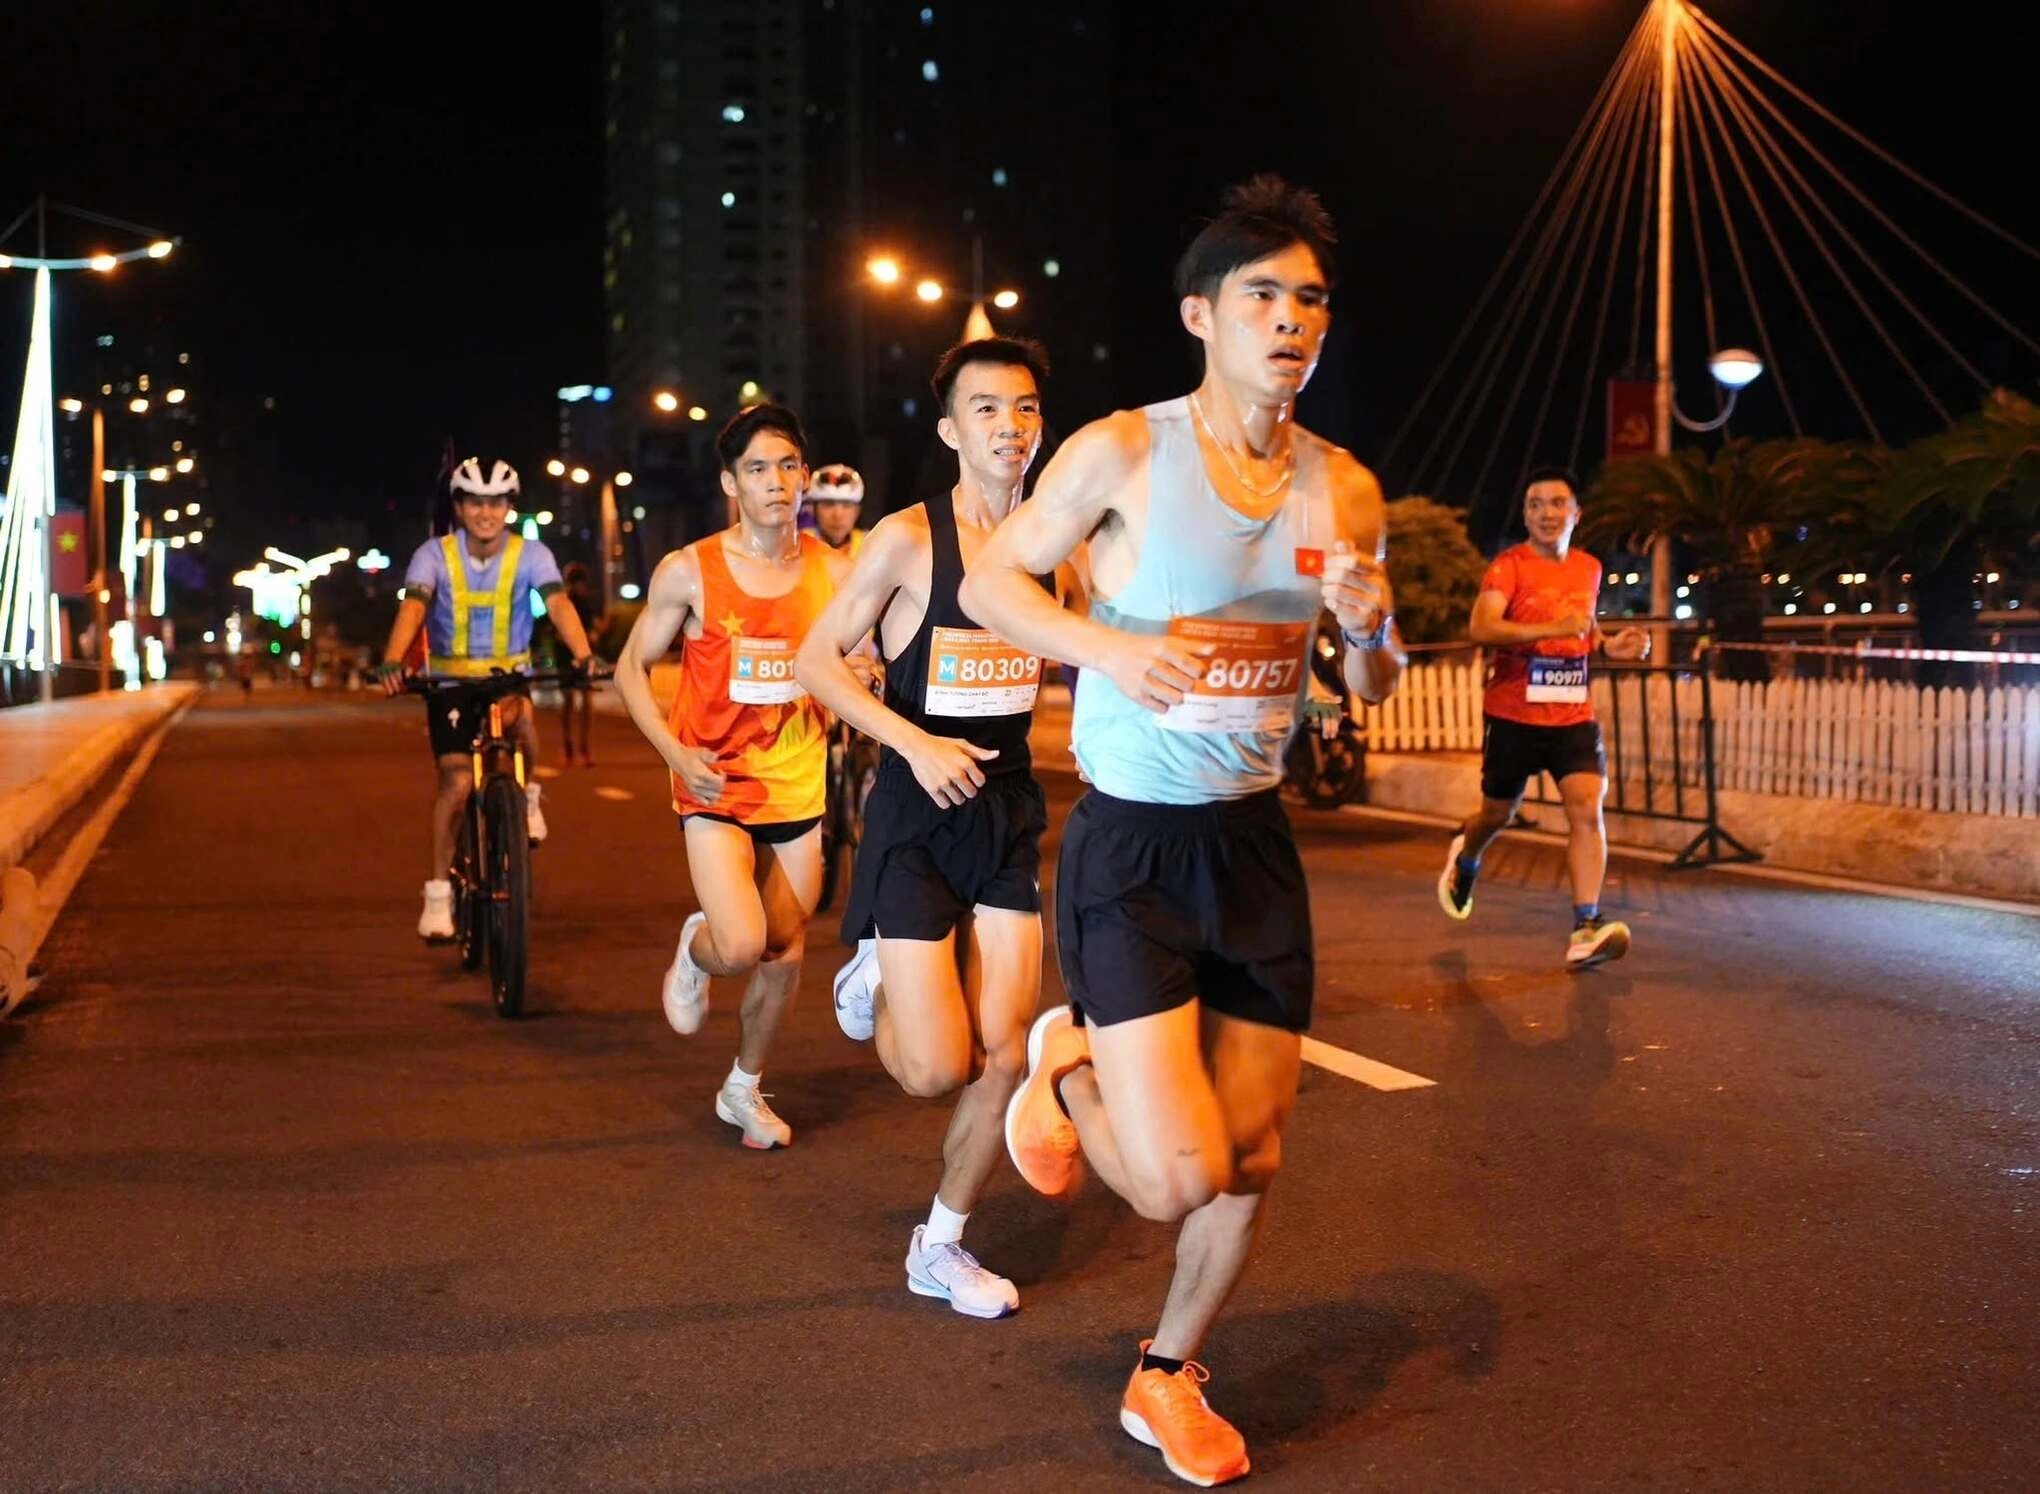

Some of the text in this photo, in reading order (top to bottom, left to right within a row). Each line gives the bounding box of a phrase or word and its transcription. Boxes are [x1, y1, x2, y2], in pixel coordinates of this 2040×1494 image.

[738, 660, 752, 674] M
[940, 656, 1038, 681] M 80309
[1206, 658, 1298, 689] 80757
[1545, 670, 1583, 685] 90977
